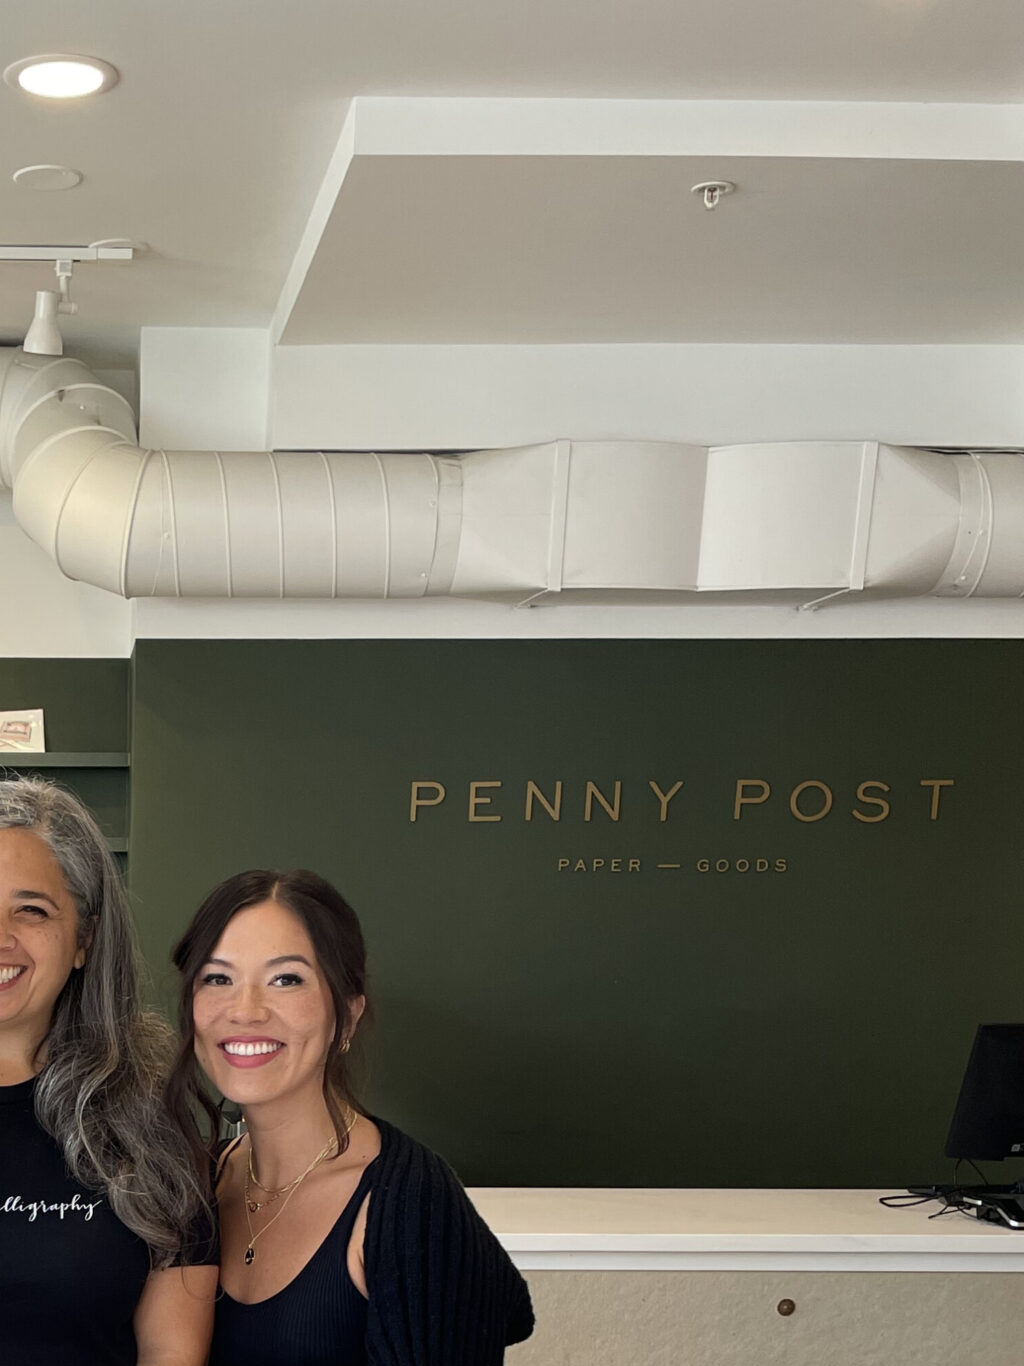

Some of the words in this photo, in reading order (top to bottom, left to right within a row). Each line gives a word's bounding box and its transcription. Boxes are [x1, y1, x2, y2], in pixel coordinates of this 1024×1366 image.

[410, 781, 683, 822] PENNY
[734, 779, 955, 823] POST
[558, 858, 642, 872] PAPER
[697, 858, 789, 873] GOODS
